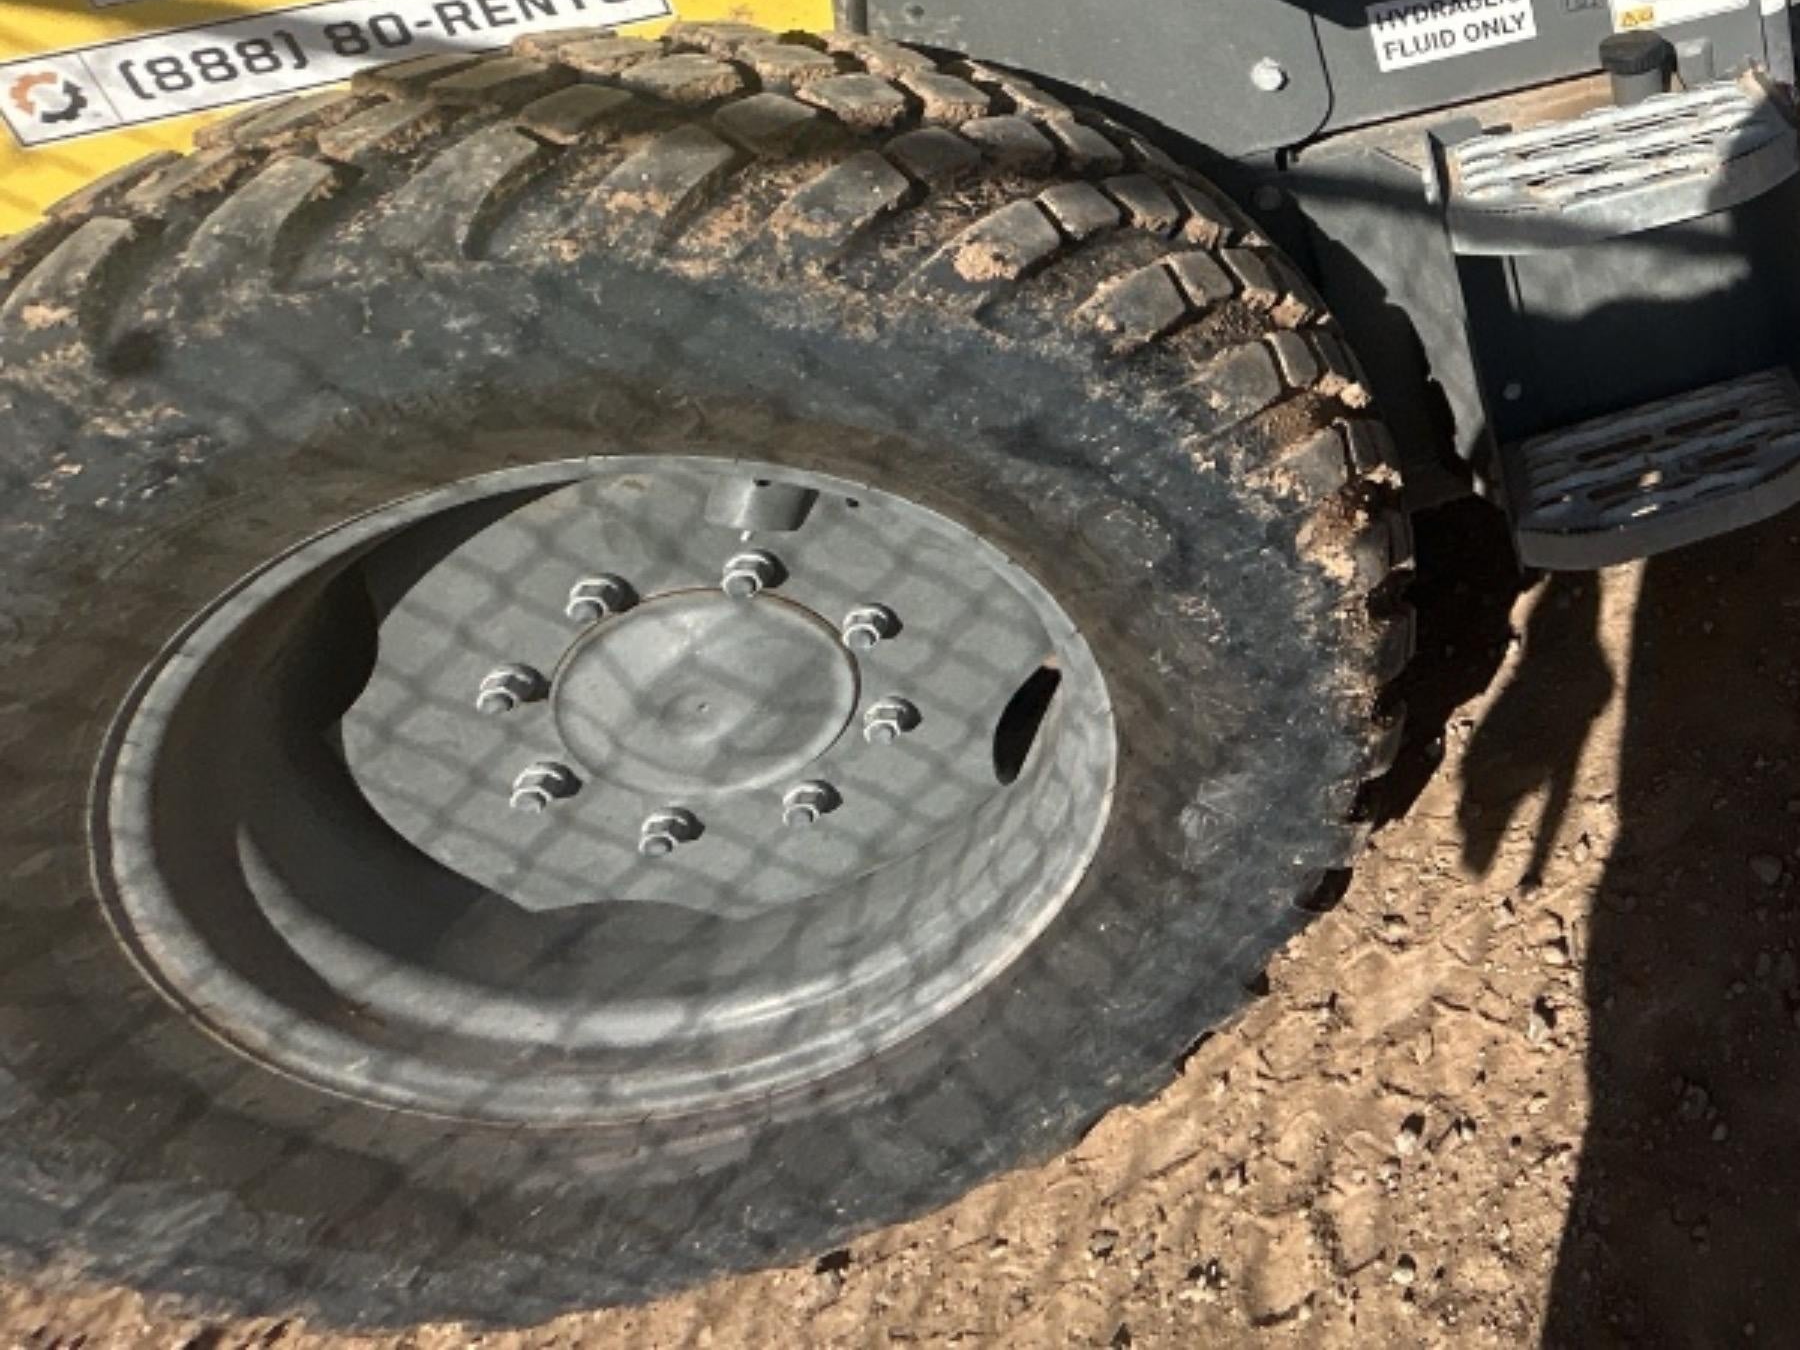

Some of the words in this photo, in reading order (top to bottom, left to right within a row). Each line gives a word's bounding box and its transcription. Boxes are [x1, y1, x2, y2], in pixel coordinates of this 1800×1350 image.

[117, 29, 310, 101] (888)
[1382, 28, 1457, 61] FLUID
[1463, 11, 1526, 43] ONLY
